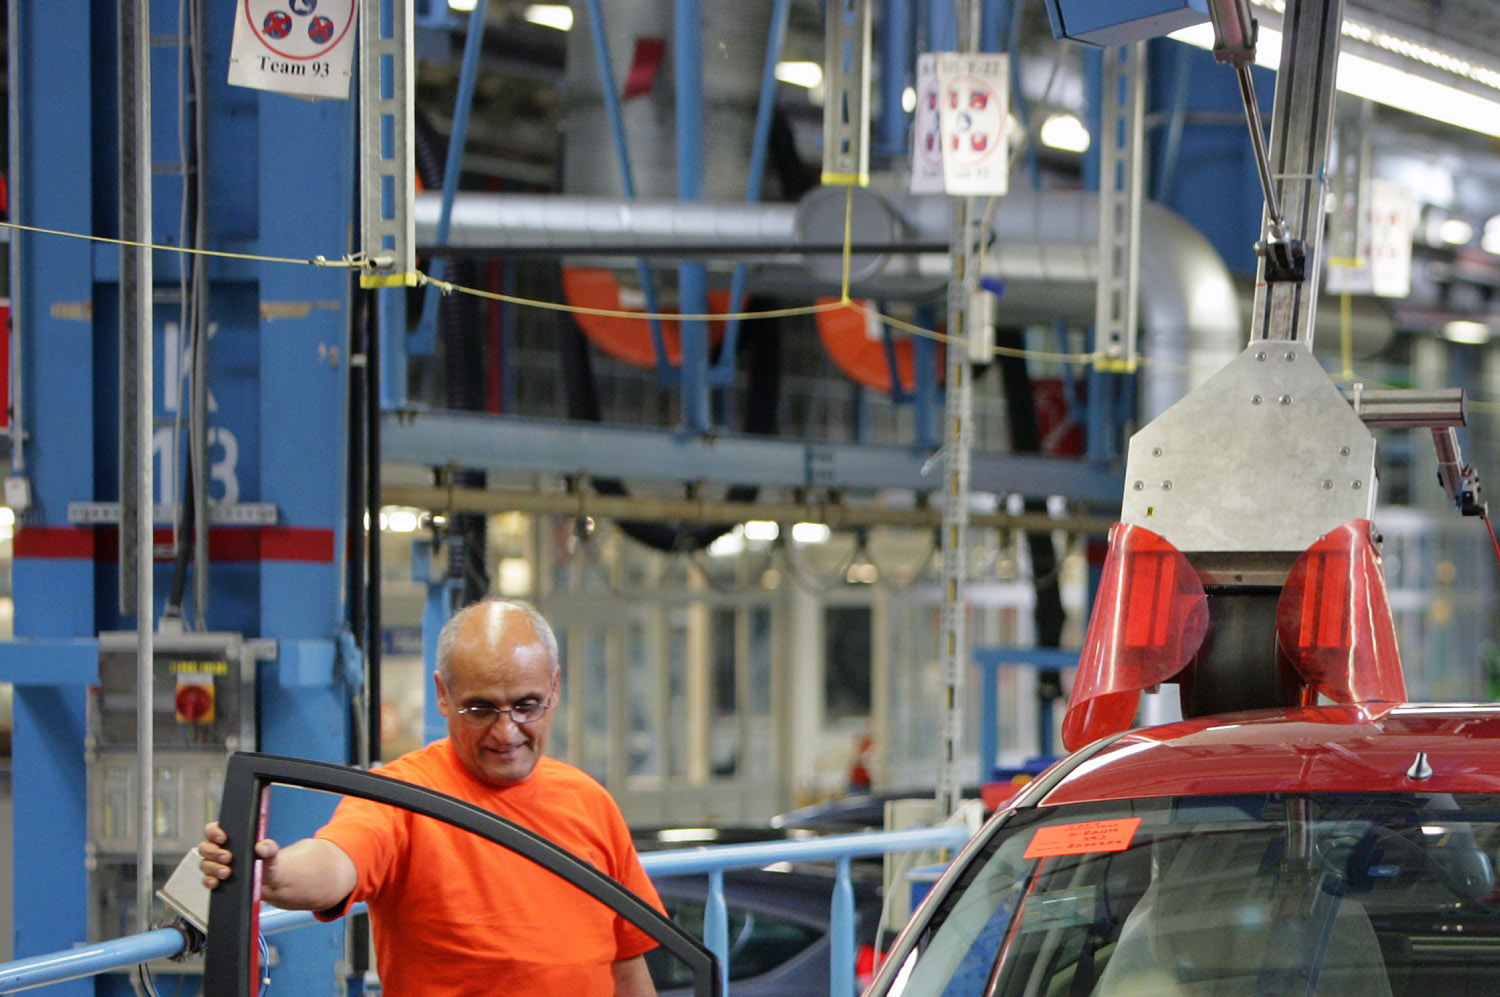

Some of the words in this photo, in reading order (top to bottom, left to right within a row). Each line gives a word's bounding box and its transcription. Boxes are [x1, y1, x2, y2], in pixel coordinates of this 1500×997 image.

[257, 54, 306, 76] Team
[311, 61, 330, 78] 93
[164, 322, 218, 412] K
[152, 426, 240, 505] 13
